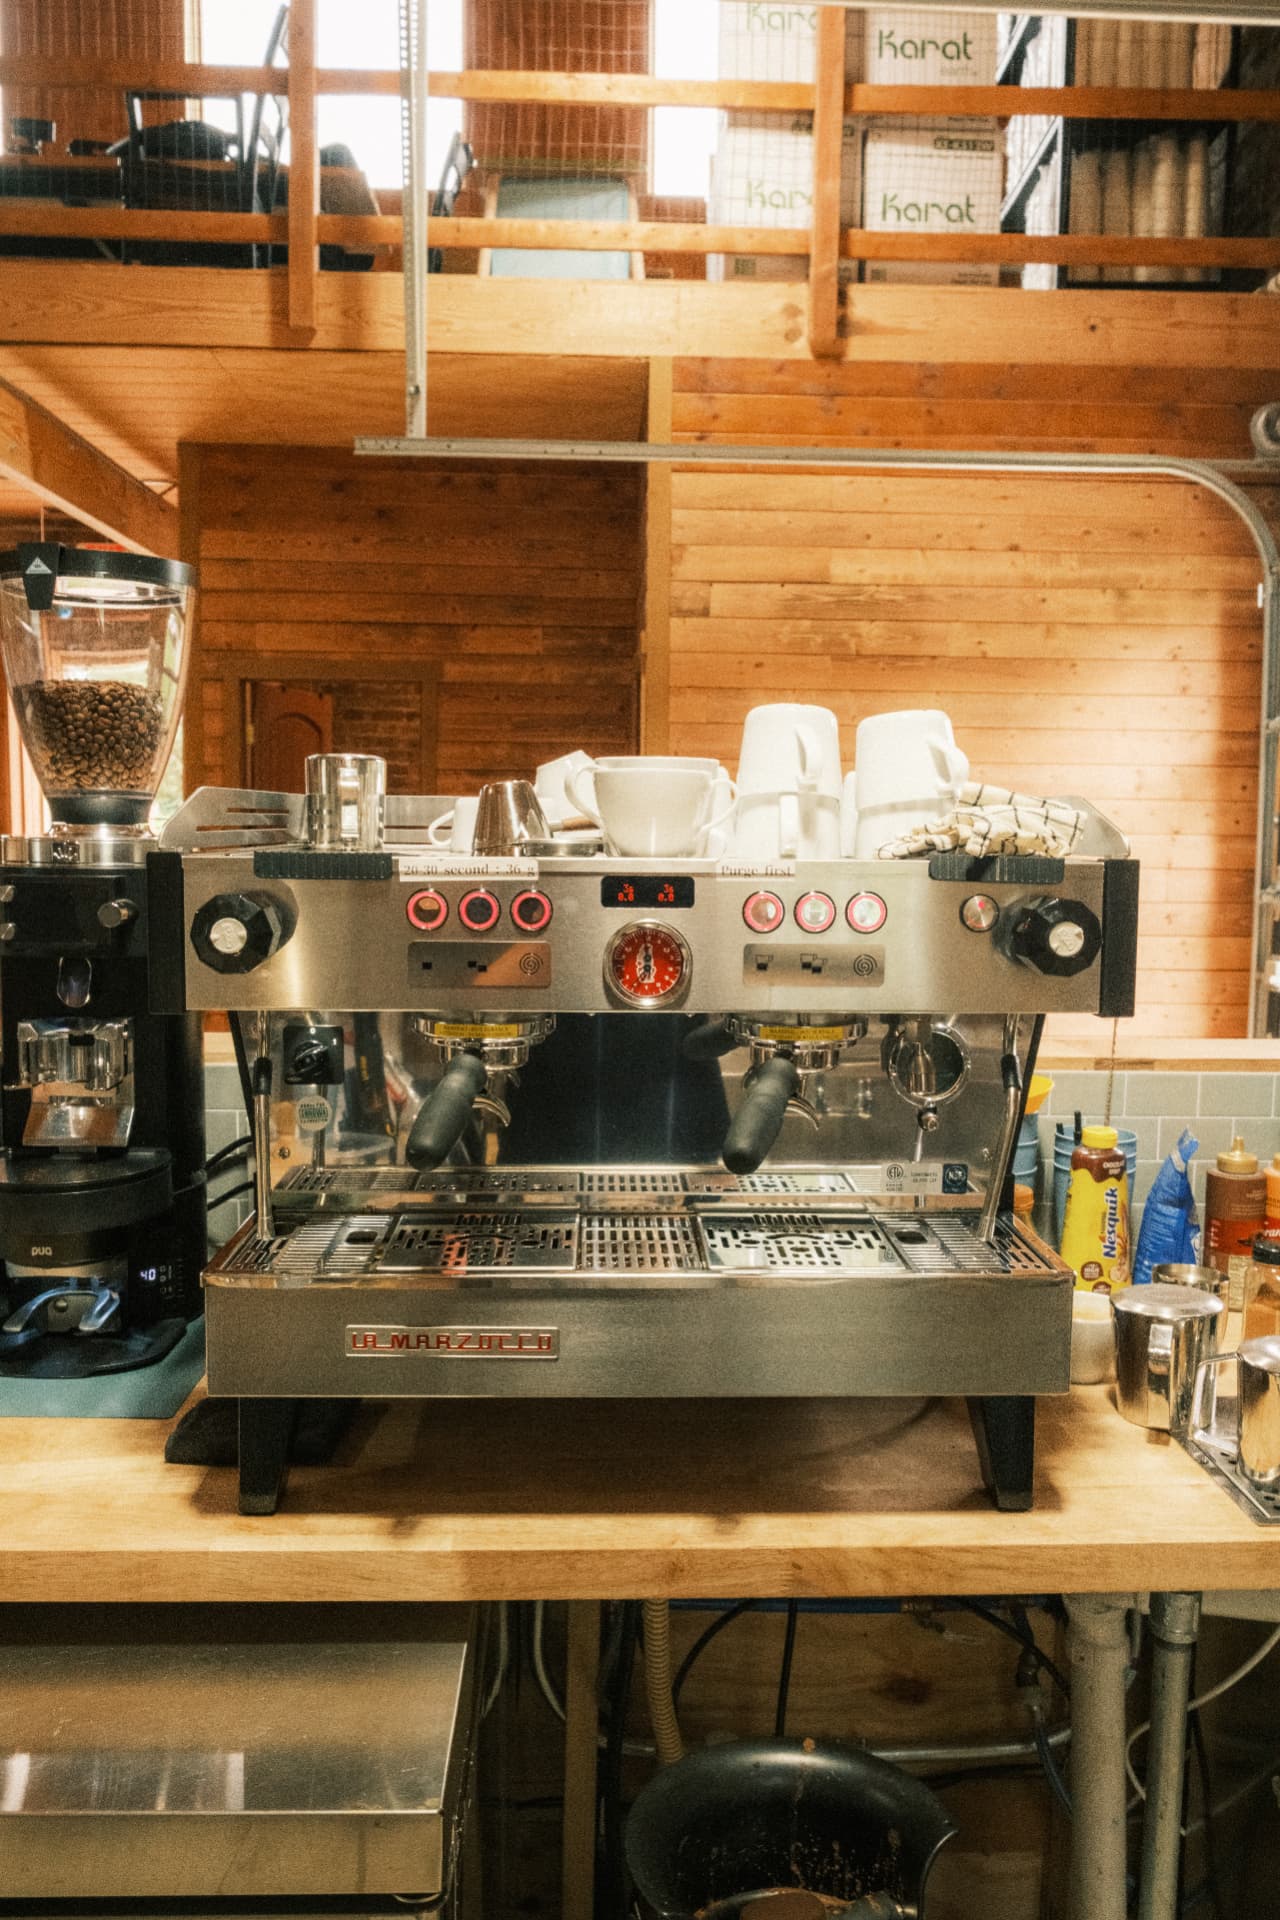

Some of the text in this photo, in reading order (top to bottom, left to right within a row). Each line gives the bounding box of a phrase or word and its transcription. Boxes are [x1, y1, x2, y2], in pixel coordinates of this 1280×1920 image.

[877, 29, 974, 61] Karat
[747, 180, 812, 209] Kar
[881, 192, 976, 223] Karat
[444, 863, 489, 876] second
[505, 863, 521, 876] 36
[721, 864, 793, 878] Purge first
[1102, 1187, 1120, 1259] Nesquik
[352, 1331, 377, 1350] LA
